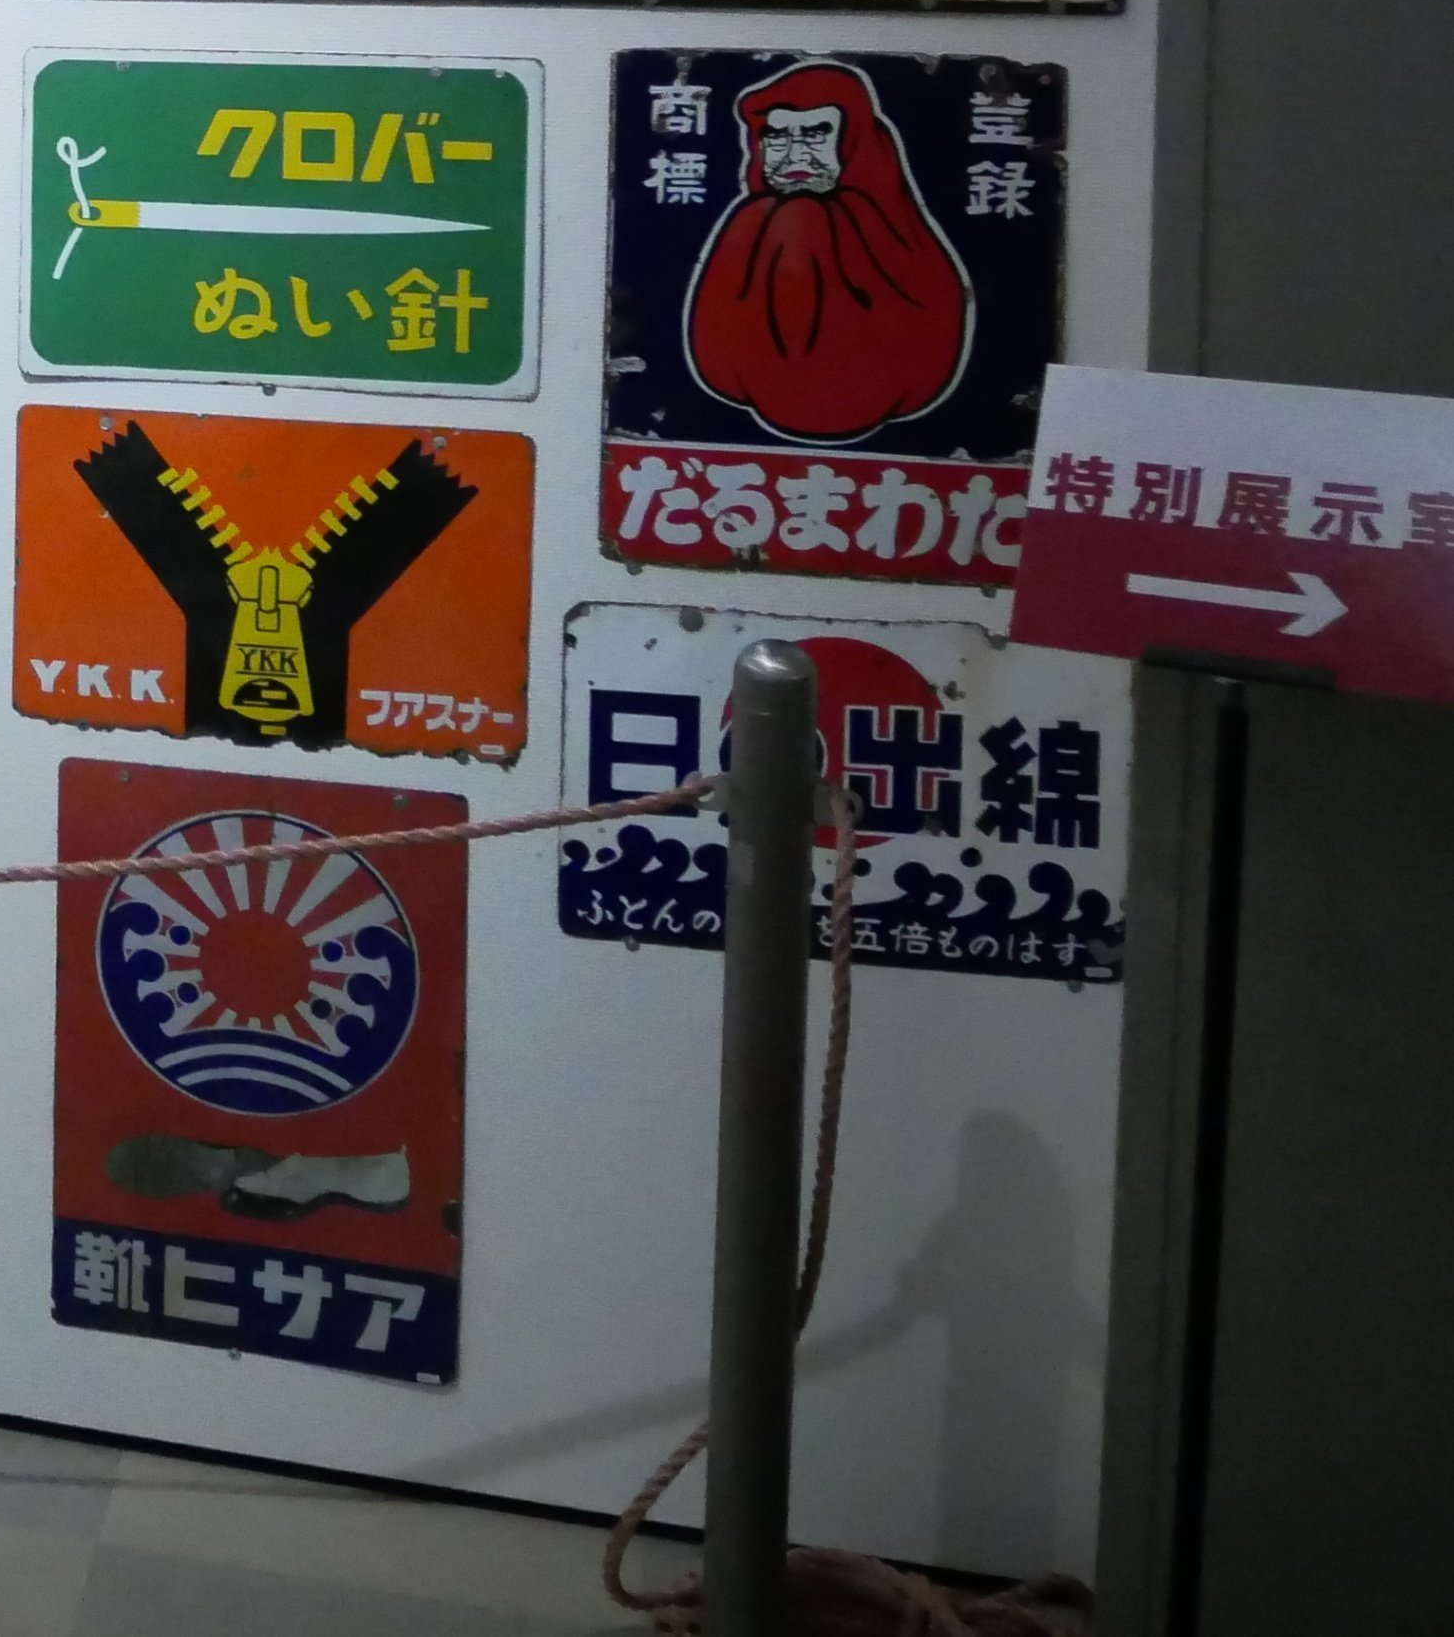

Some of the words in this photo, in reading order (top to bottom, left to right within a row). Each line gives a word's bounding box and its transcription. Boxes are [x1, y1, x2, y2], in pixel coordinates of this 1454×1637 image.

[197, 108, 493, 185] クロバー
[642, 82, 712, 206] 商標
[193, 266, 490, 355] ぬい針
[618, 455, 1025, 565] だるまわた
[1044, 451, 1454, 548] 特別展示室
[236, 646, 299, 674] YKK
